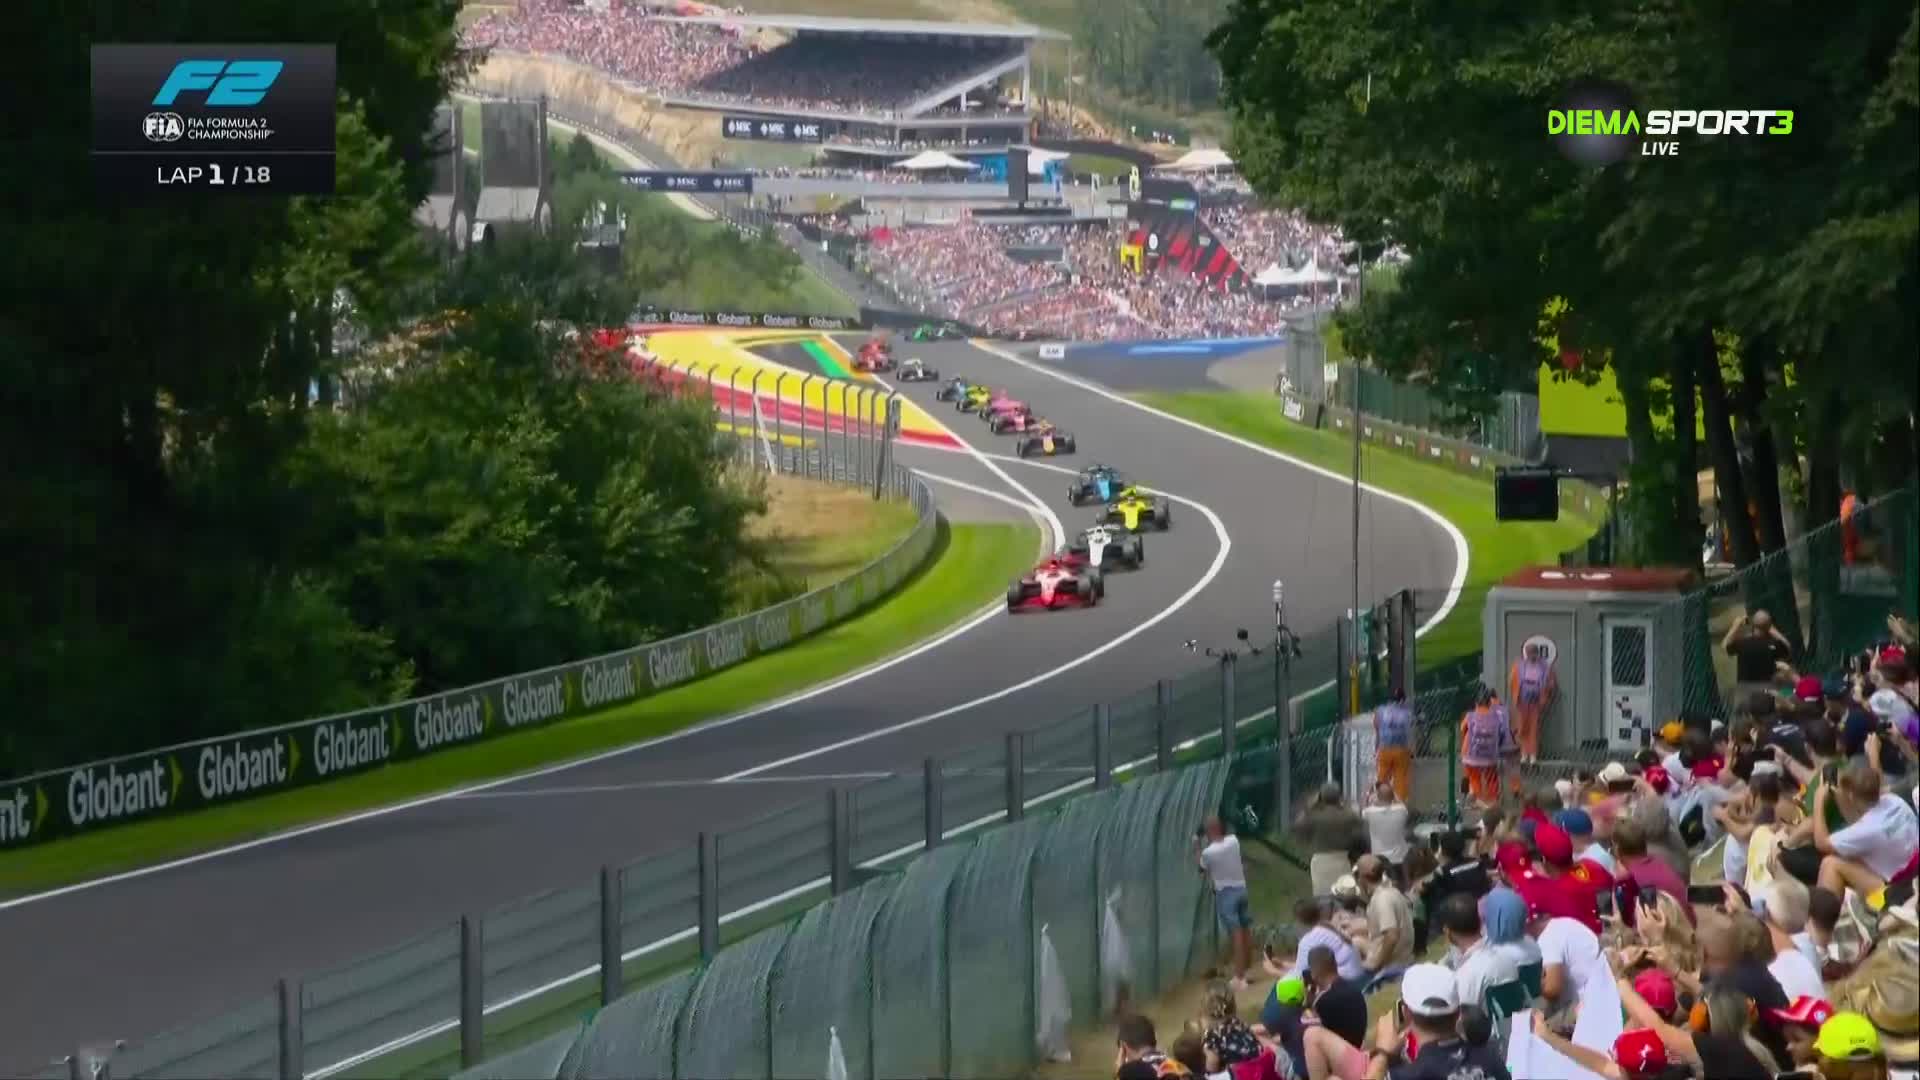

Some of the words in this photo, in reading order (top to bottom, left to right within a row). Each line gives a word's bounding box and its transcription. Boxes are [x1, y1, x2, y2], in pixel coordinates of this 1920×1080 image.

[802, 125, 819, 136] MSC
[630, 177, 651, 185] MSC
[677, 178, 697, 186] MSC
[68, 759, 168, 825] Globant
[199, 737, 286, 799] Globant
[314, 717, 389, 775] Globant
[415, 694, 483, 749] Globant
[503, 676, 565, 726] Globant
[581, 659, 636, 708] Globant
[650, 640, 695, 689] Globant
